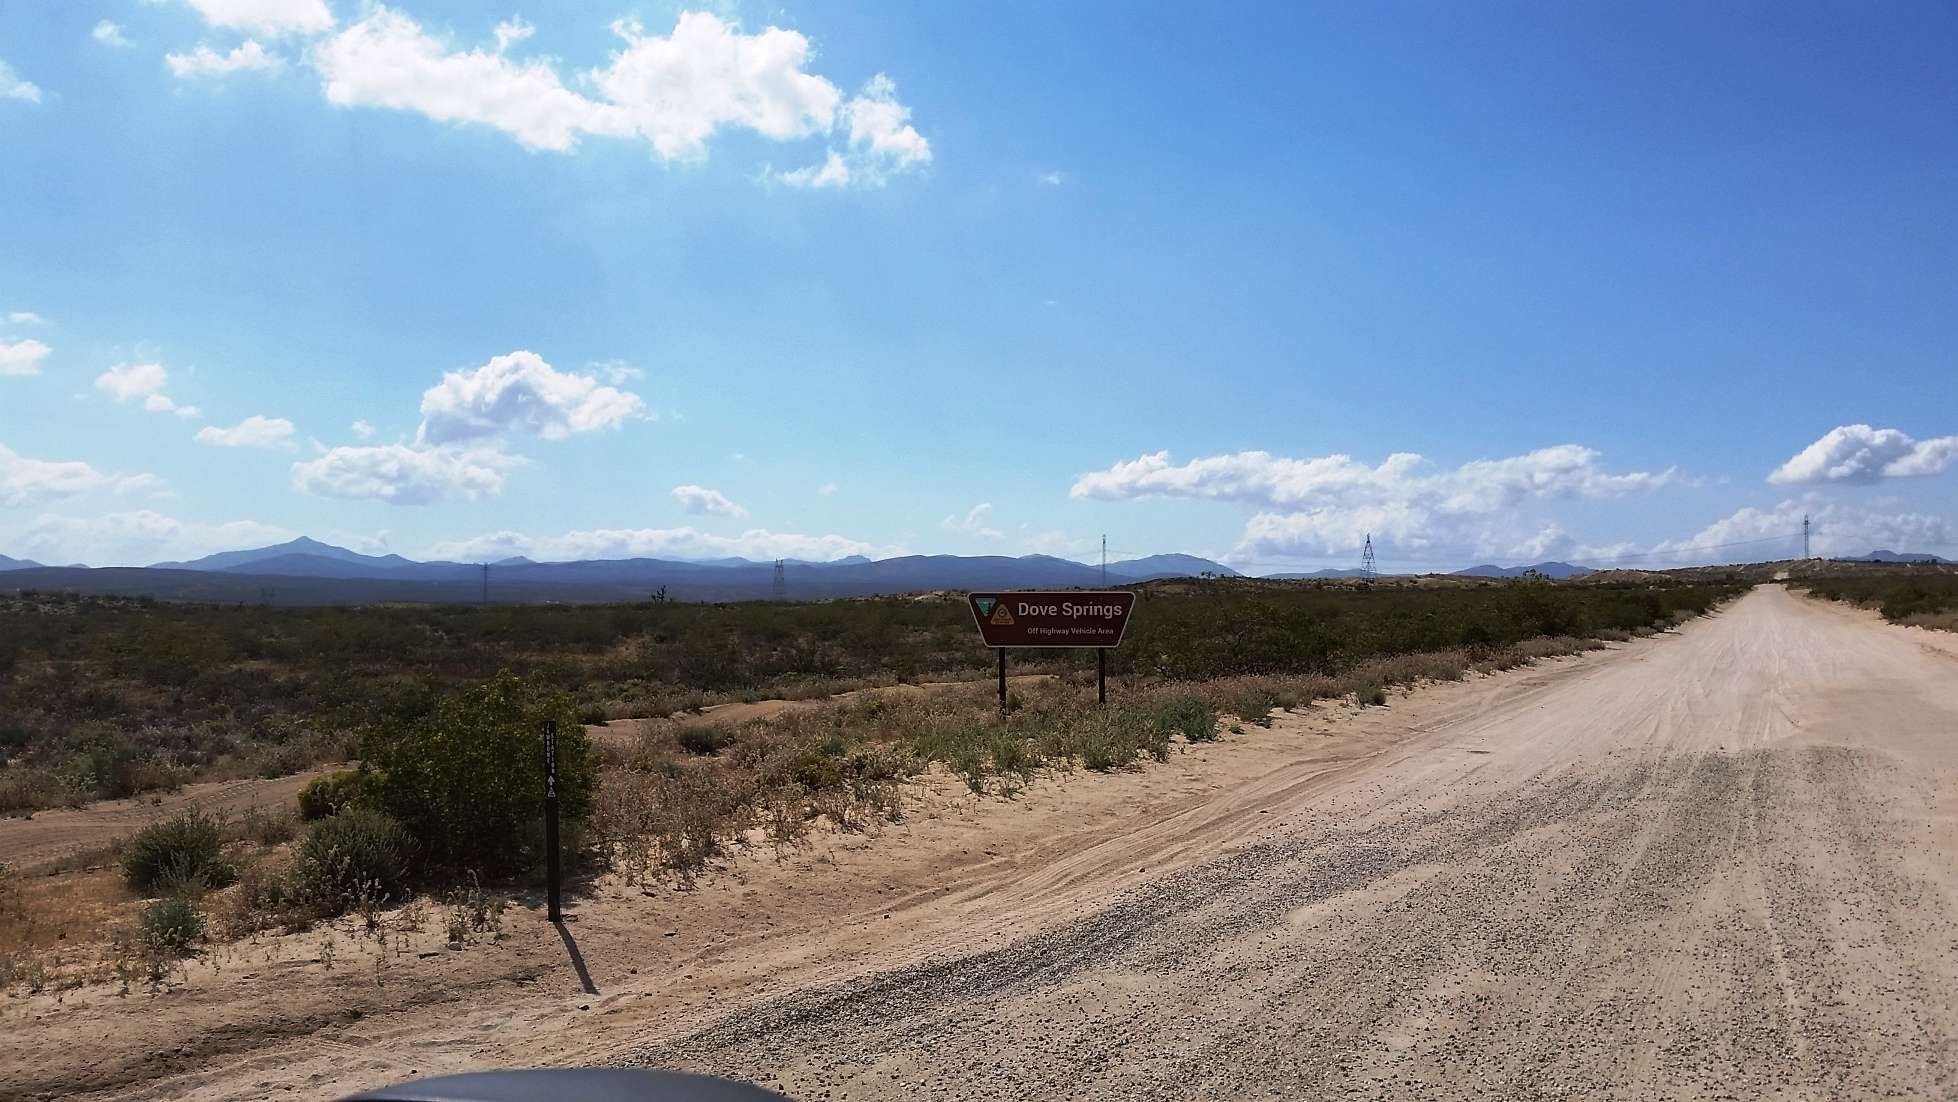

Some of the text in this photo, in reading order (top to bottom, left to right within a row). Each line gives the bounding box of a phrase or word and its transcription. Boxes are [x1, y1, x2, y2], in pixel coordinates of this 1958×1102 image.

[1018, 601, 1122, 619] Dove Springs
[1027, 627, 1114, 636] Off Highway Vehicle Area
